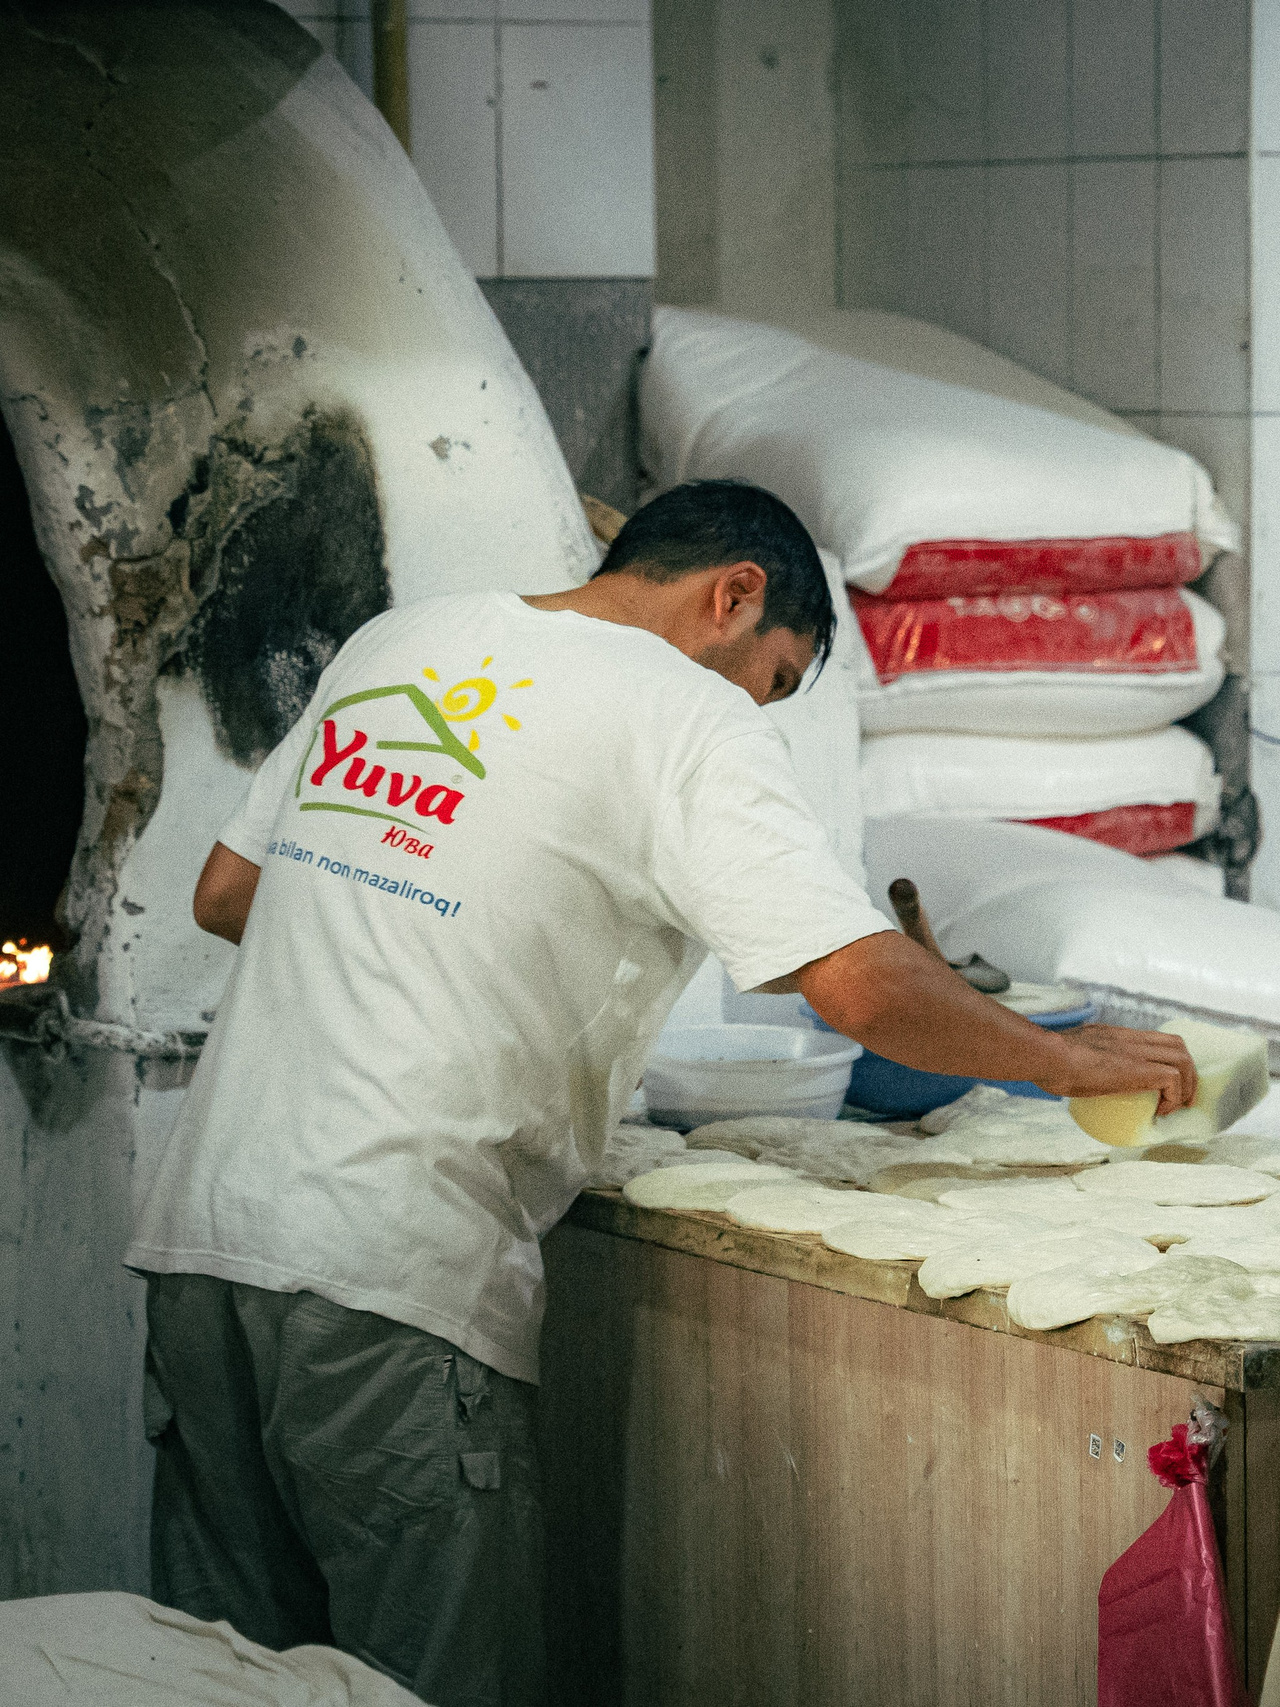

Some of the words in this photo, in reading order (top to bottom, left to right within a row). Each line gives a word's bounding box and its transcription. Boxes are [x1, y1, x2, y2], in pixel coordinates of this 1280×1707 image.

[310, 720, 465, 825] Yuva
[279, 839, 314, 864] bilan
[317, 856, 351, 878] non
